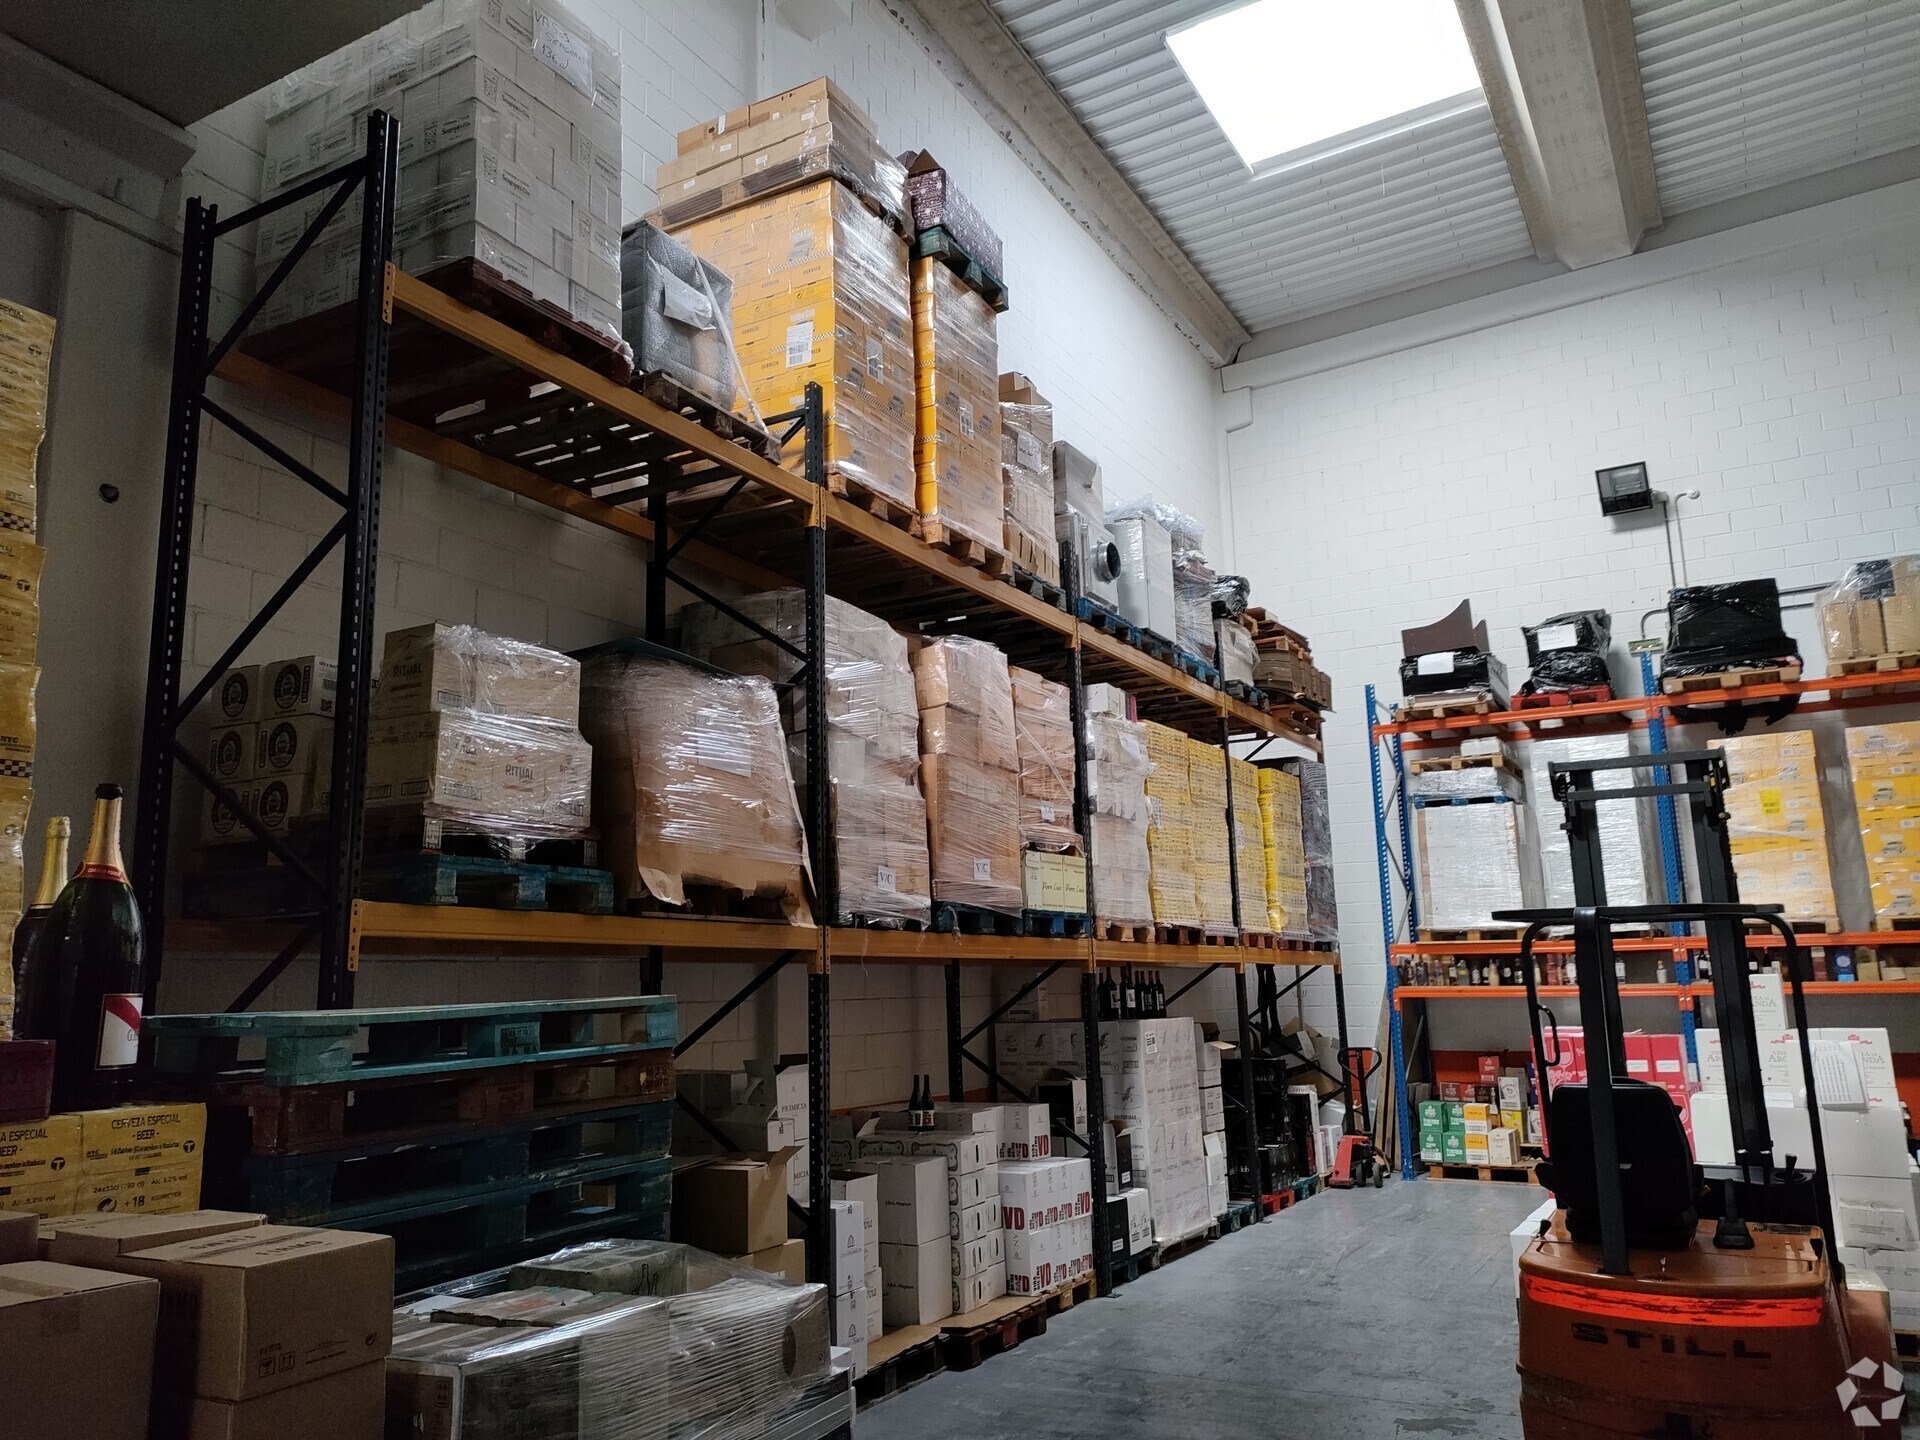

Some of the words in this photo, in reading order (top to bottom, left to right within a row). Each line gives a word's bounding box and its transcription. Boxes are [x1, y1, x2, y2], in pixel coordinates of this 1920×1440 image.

[394, 662, 423, 678] RITUAL
[505, 763, 534, 780] RITUAL
[782, 1102, 808, 1112] PRIMICIA
[112, 1116, 146, 1130] CERVEZA
[147, 1113, 181, 1126] ESPECIAL
[9, 1128, 48, 1142] ESPECIAL
[1080, 1192, 1090, 1214] VD
[1002, 1206, 1025, 1230] VD
[1040, 1262, 1051, 1288] VD
[1572, 1322, 1772, 1360] STILL
